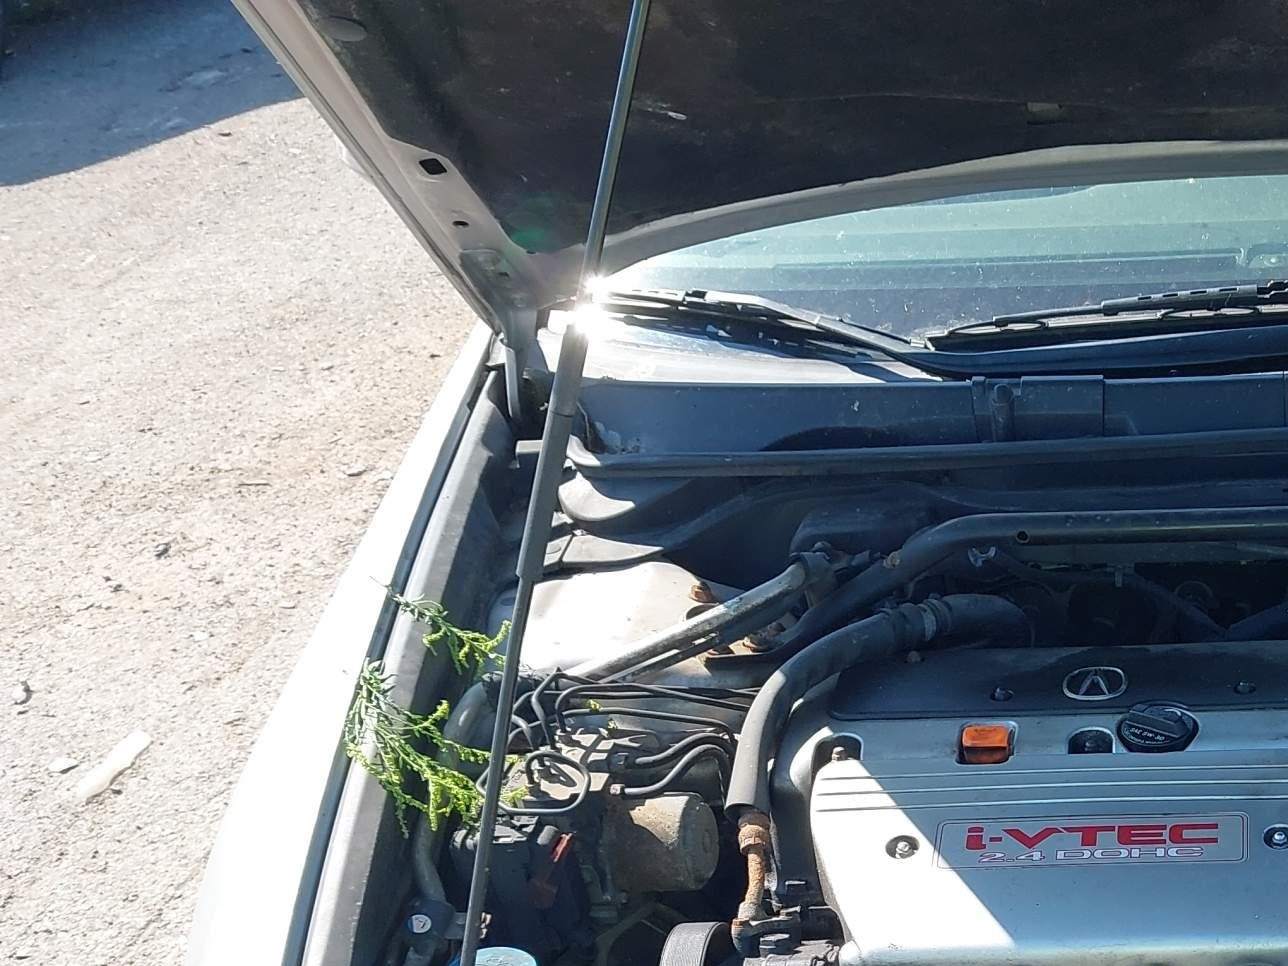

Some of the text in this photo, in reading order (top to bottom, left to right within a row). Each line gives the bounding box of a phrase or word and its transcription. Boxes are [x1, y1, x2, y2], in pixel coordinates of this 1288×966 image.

[965, 823, 1219, 851] i-VTEC
[978, 847, 1204, 864] 2.4 DOHC
